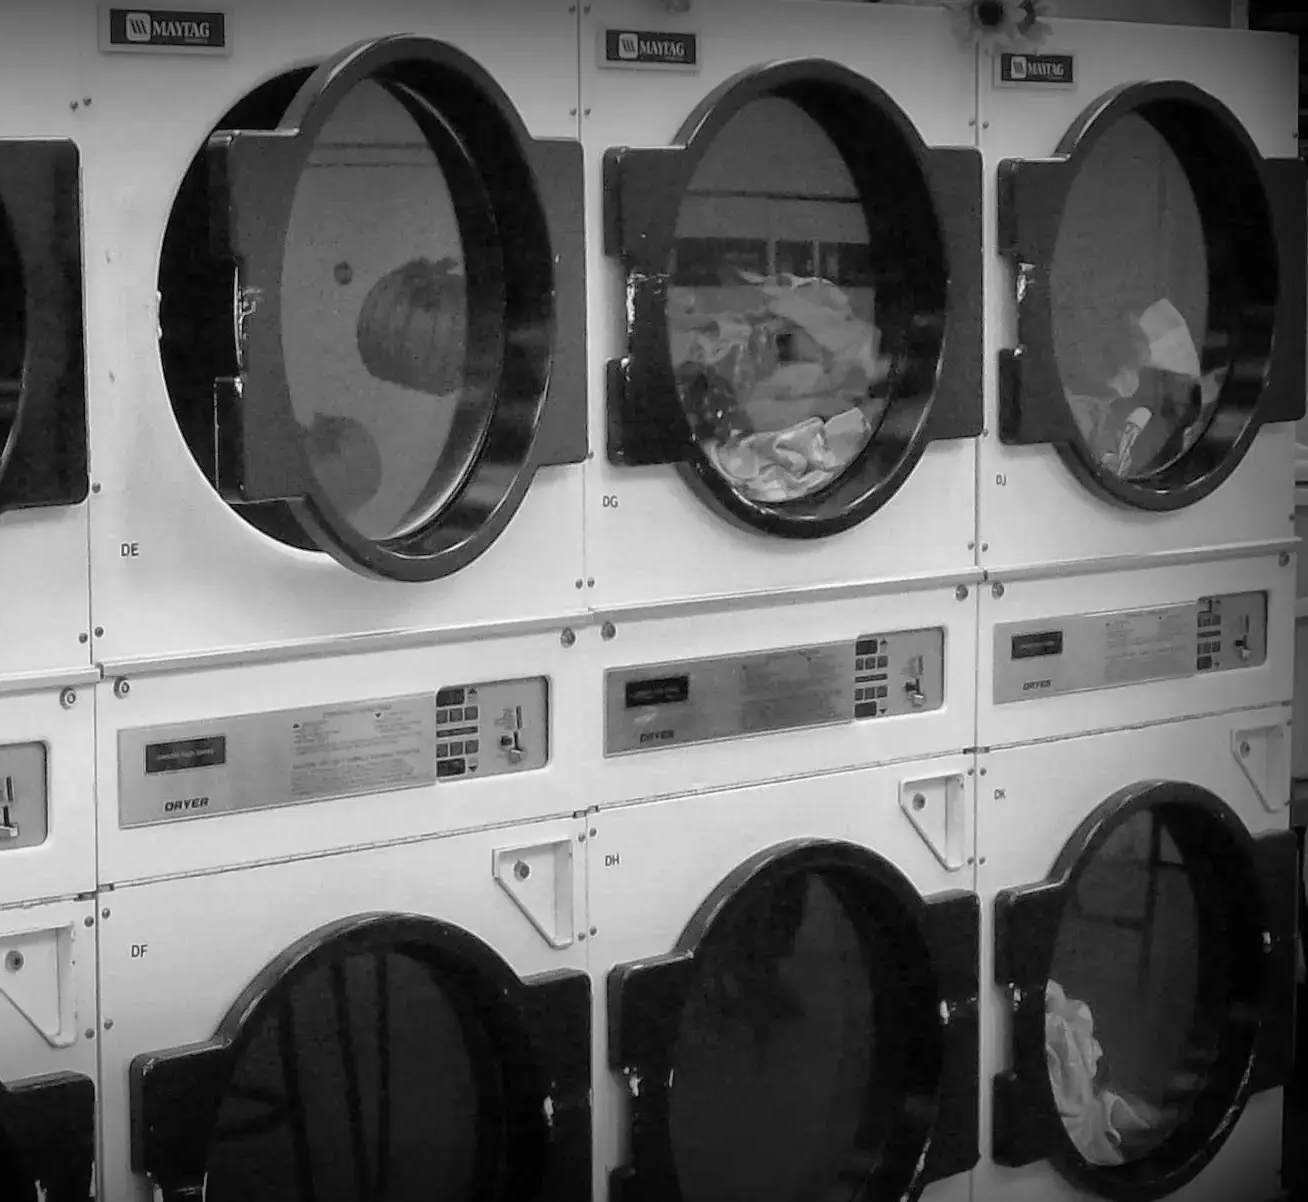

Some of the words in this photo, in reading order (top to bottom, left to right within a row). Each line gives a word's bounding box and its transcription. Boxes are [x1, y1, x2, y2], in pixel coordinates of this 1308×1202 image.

[152, 20, 210, 38] MAYTAG
[638, 39, 685, 56] MAYTAG
[1028, 62, 1064, 76] MAYTAG
[996, 474, 1007, 486] DJ
[603, 495, 618, 508] DG
[121, 542, 139, 557] DE
[164, 797, 210, 812] DRYER
[605, 853, 620, 867] DH
[131, 944, 148, 958] DF
